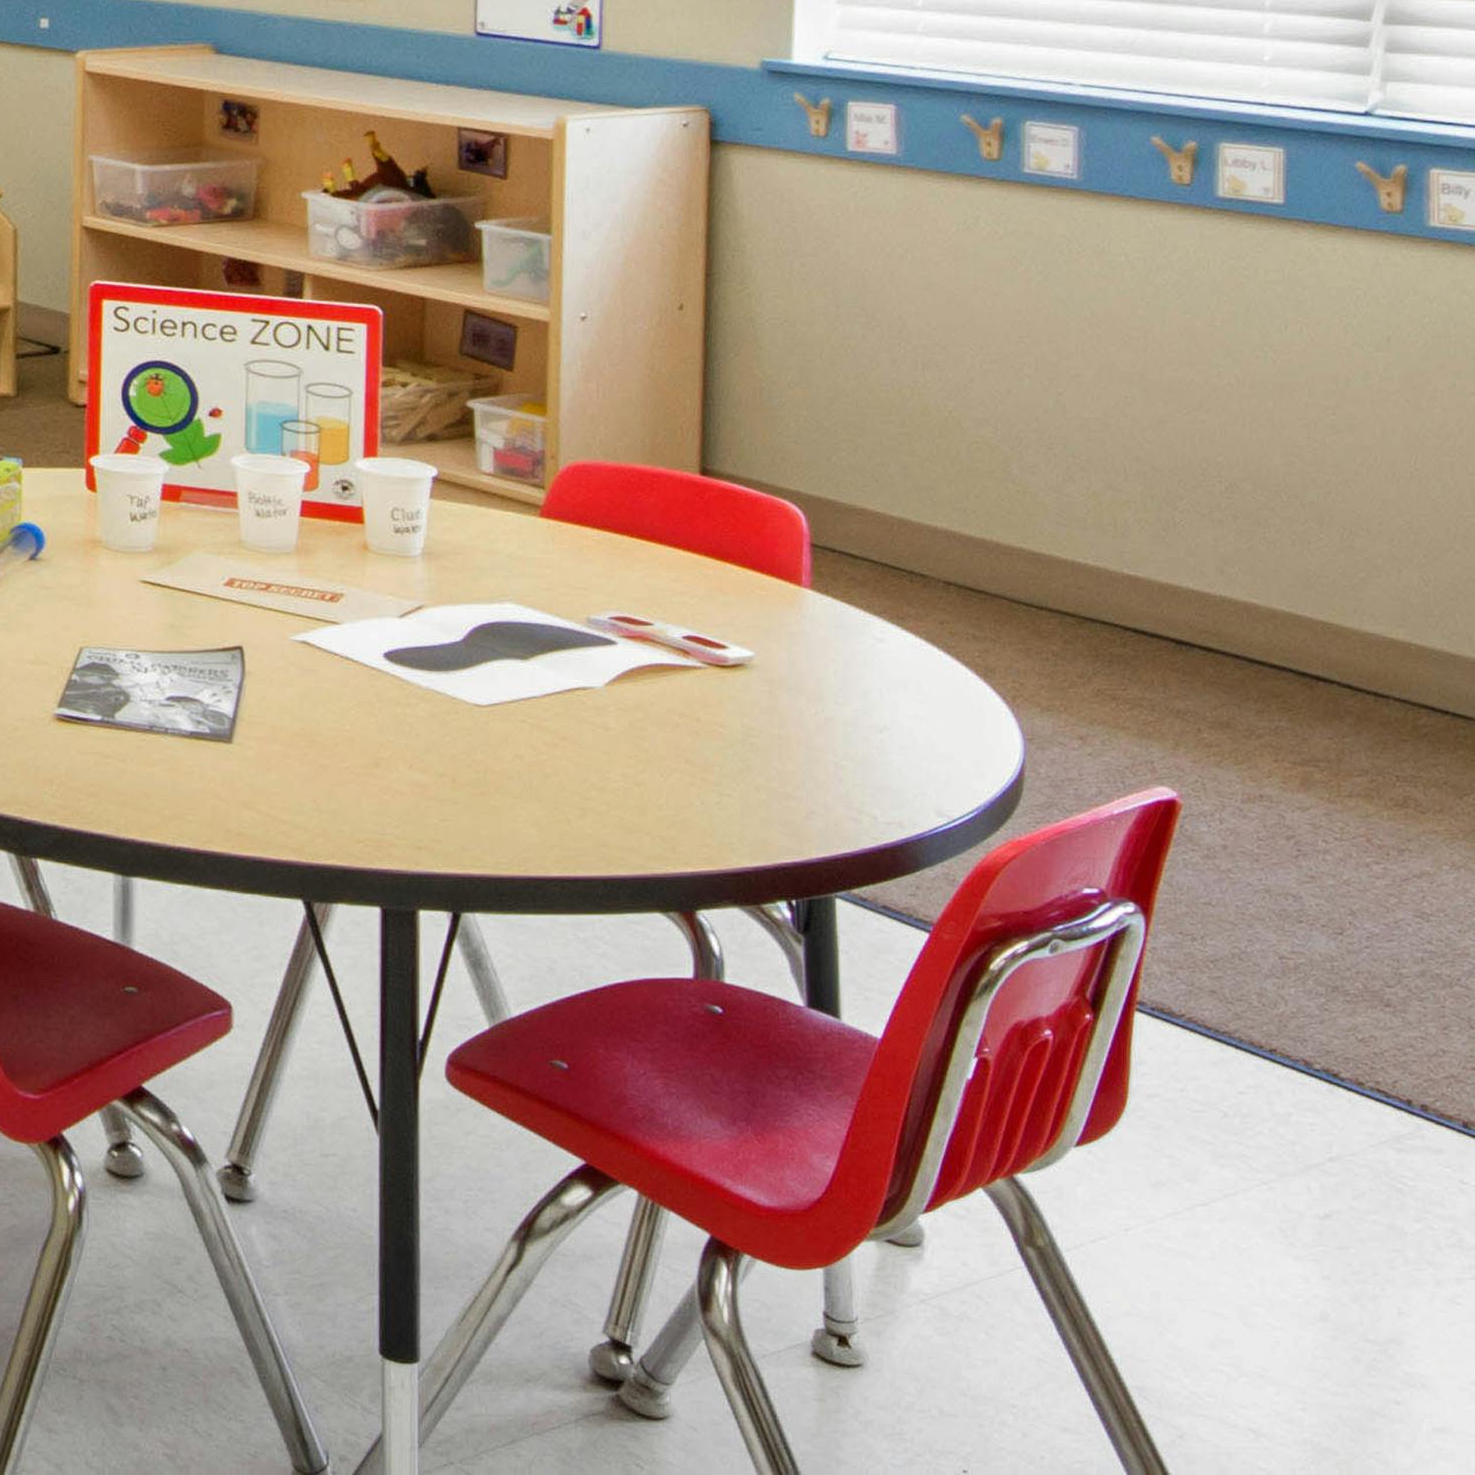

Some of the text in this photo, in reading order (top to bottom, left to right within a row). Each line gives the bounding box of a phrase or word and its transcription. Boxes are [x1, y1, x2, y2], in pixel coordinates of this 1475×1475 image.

[112, 305, 356, 355] Science ZONE
[126, 493, 151, 510] Tap
[231, 579, 268, 592] TOP
